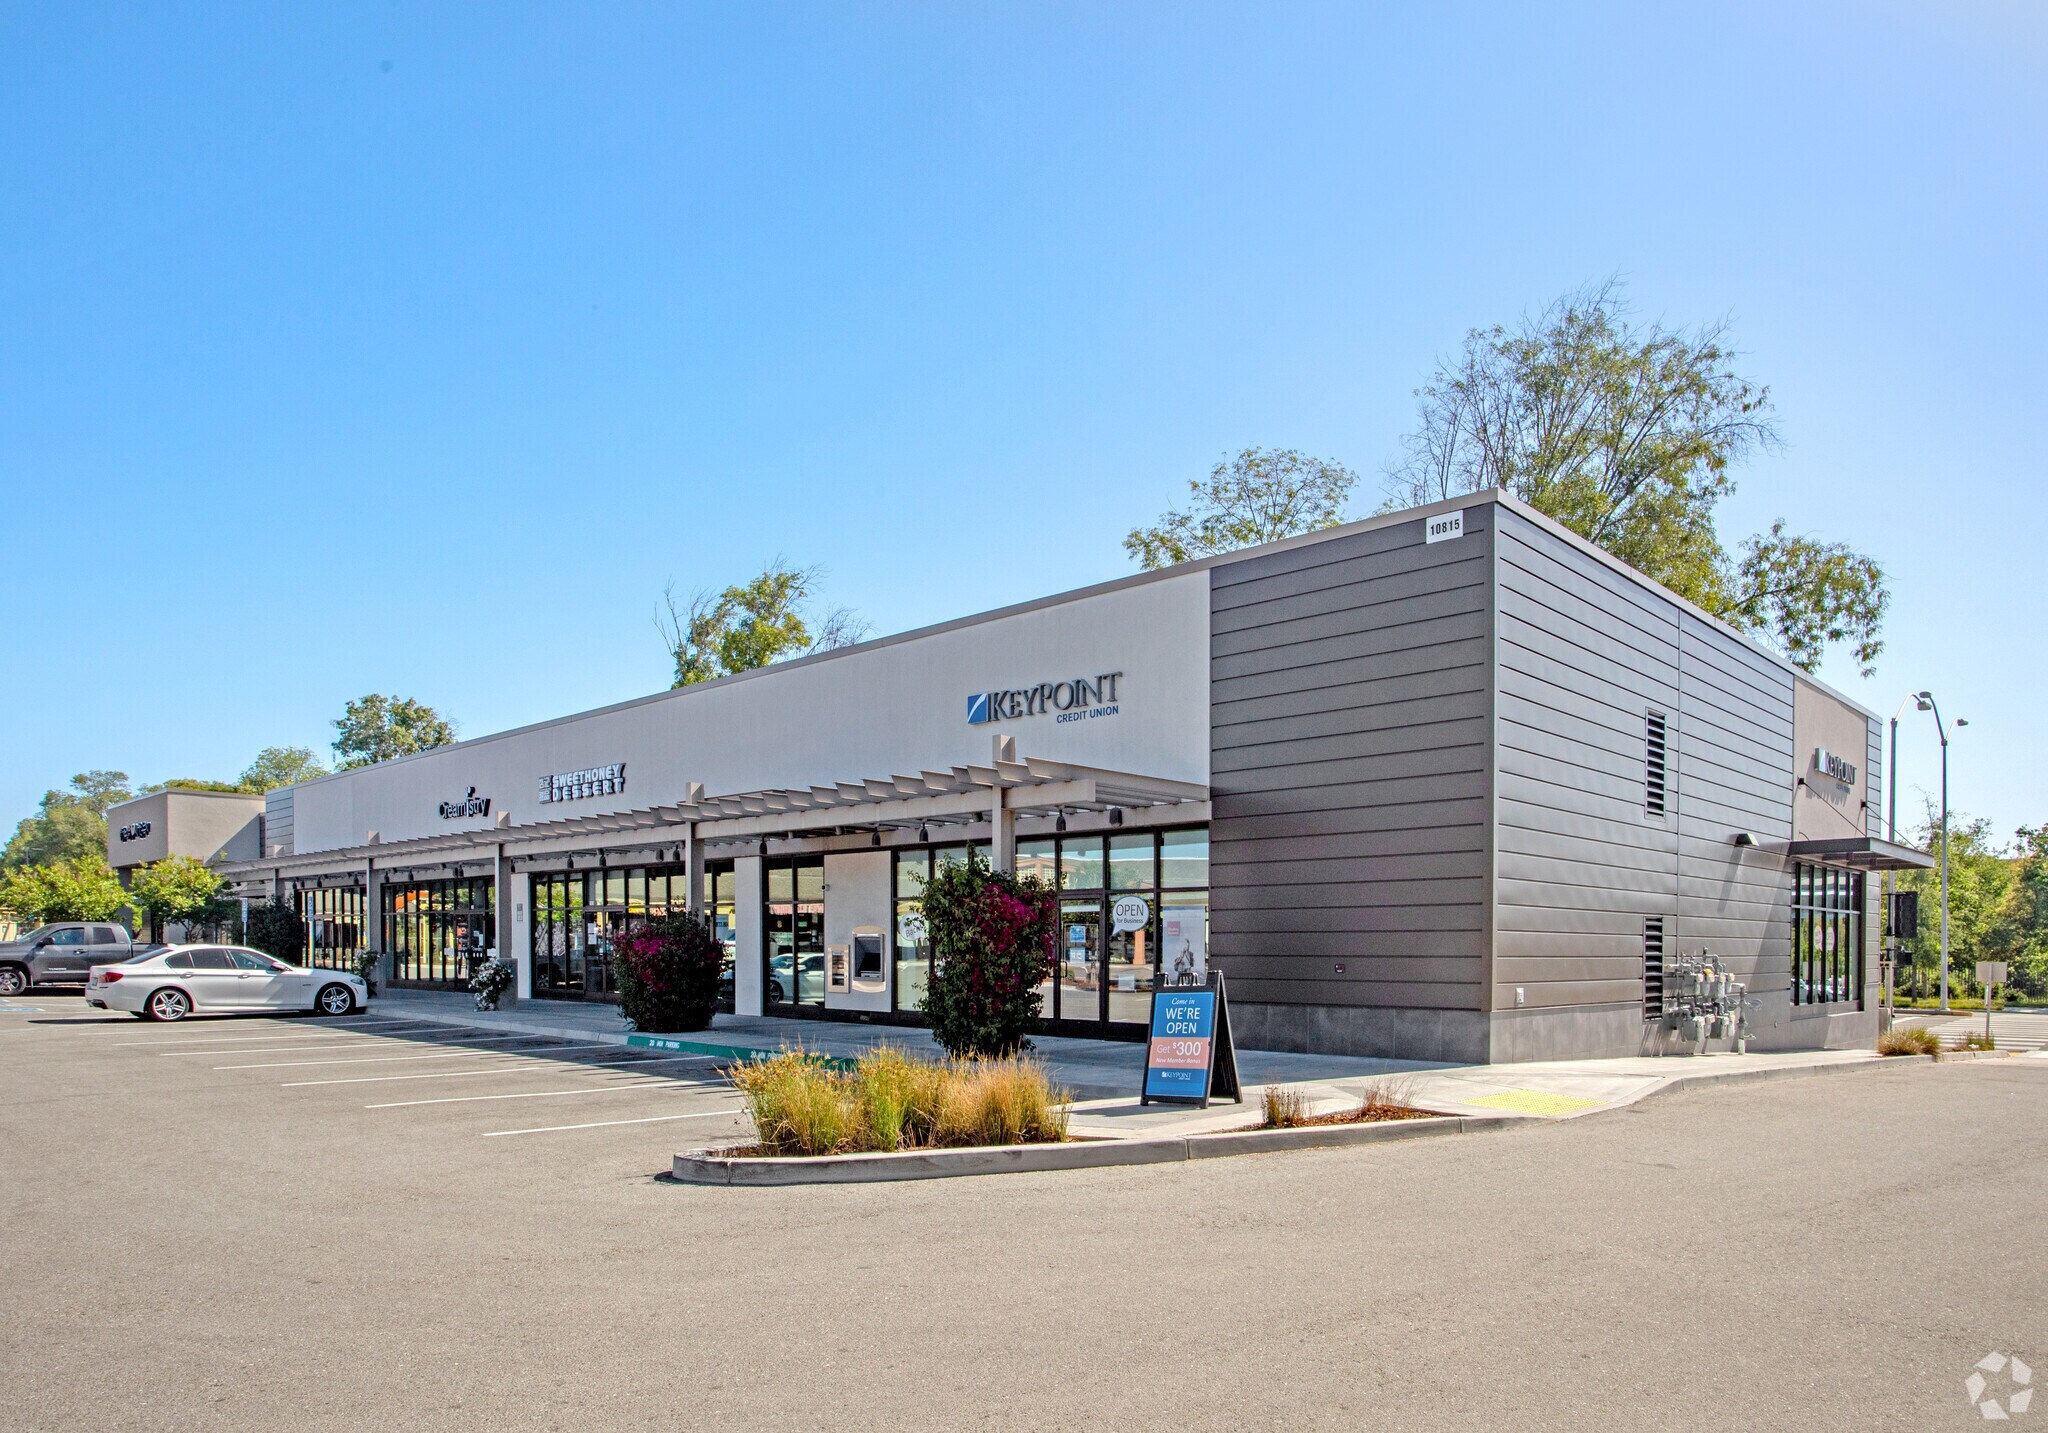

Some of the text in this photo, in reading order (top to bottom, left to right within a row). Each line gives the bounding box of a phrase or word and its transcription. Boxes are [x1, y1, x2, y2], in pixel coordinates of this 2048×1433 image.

[1430, 519, 1460, 536] 10815
[988, 671, 1123, 722] KEYPOINT
[1056, 705, 1119, 724] CREDIT UNION
[552, 762, 626, 789] SWEETHONEY
[552, 777, 625, 802] DESSERT
[1115, 904, 1144, 916] OPEN
[1171, 997, 1195, 1005] Come in
[1165, 1007, 1201, 1020] WE'RE
[1166, 1022, 1197, 1034] OPEN
[1156, 1044, 1170, 1054] Get
[1166, 1071, 1191, 1079] KEYPOINT
